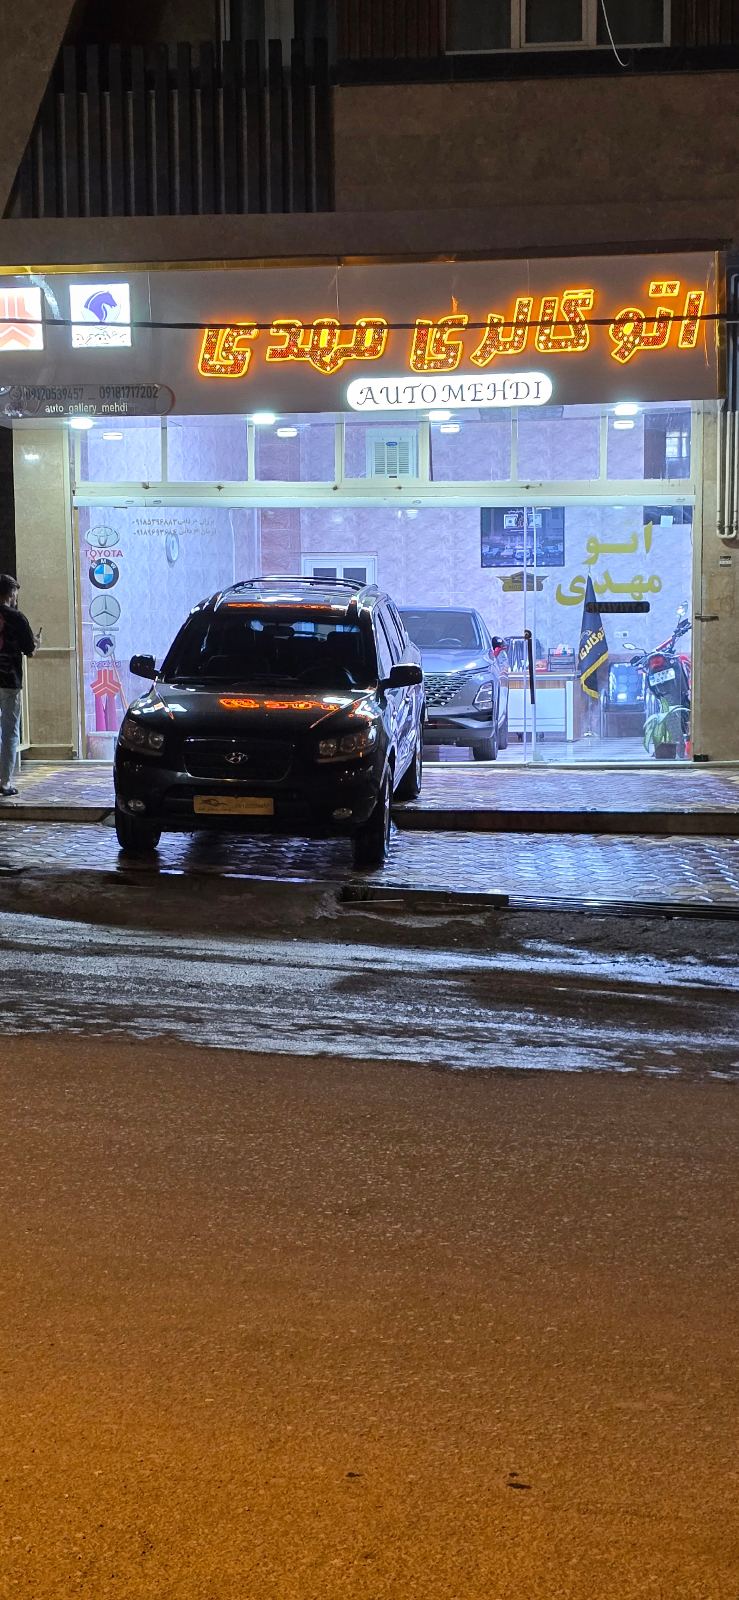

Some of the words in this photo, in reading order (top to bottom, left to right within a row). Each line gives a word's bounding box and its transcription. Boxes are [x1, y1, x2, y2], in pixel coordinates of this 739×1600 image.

[409, 288, 595, 373] گالری
[608, 280, 705, 365] اتو
[197, 317, 389, 378] مهدی
[100, 385, 159, 400] 09181717202
[44, 401, 128, 415] auto_gallery_mehdi
[84, 549, 124, 558] TOYOTA
[91, 558, 117, 569] BMW
[555, 569, 663, 606] مهدی
